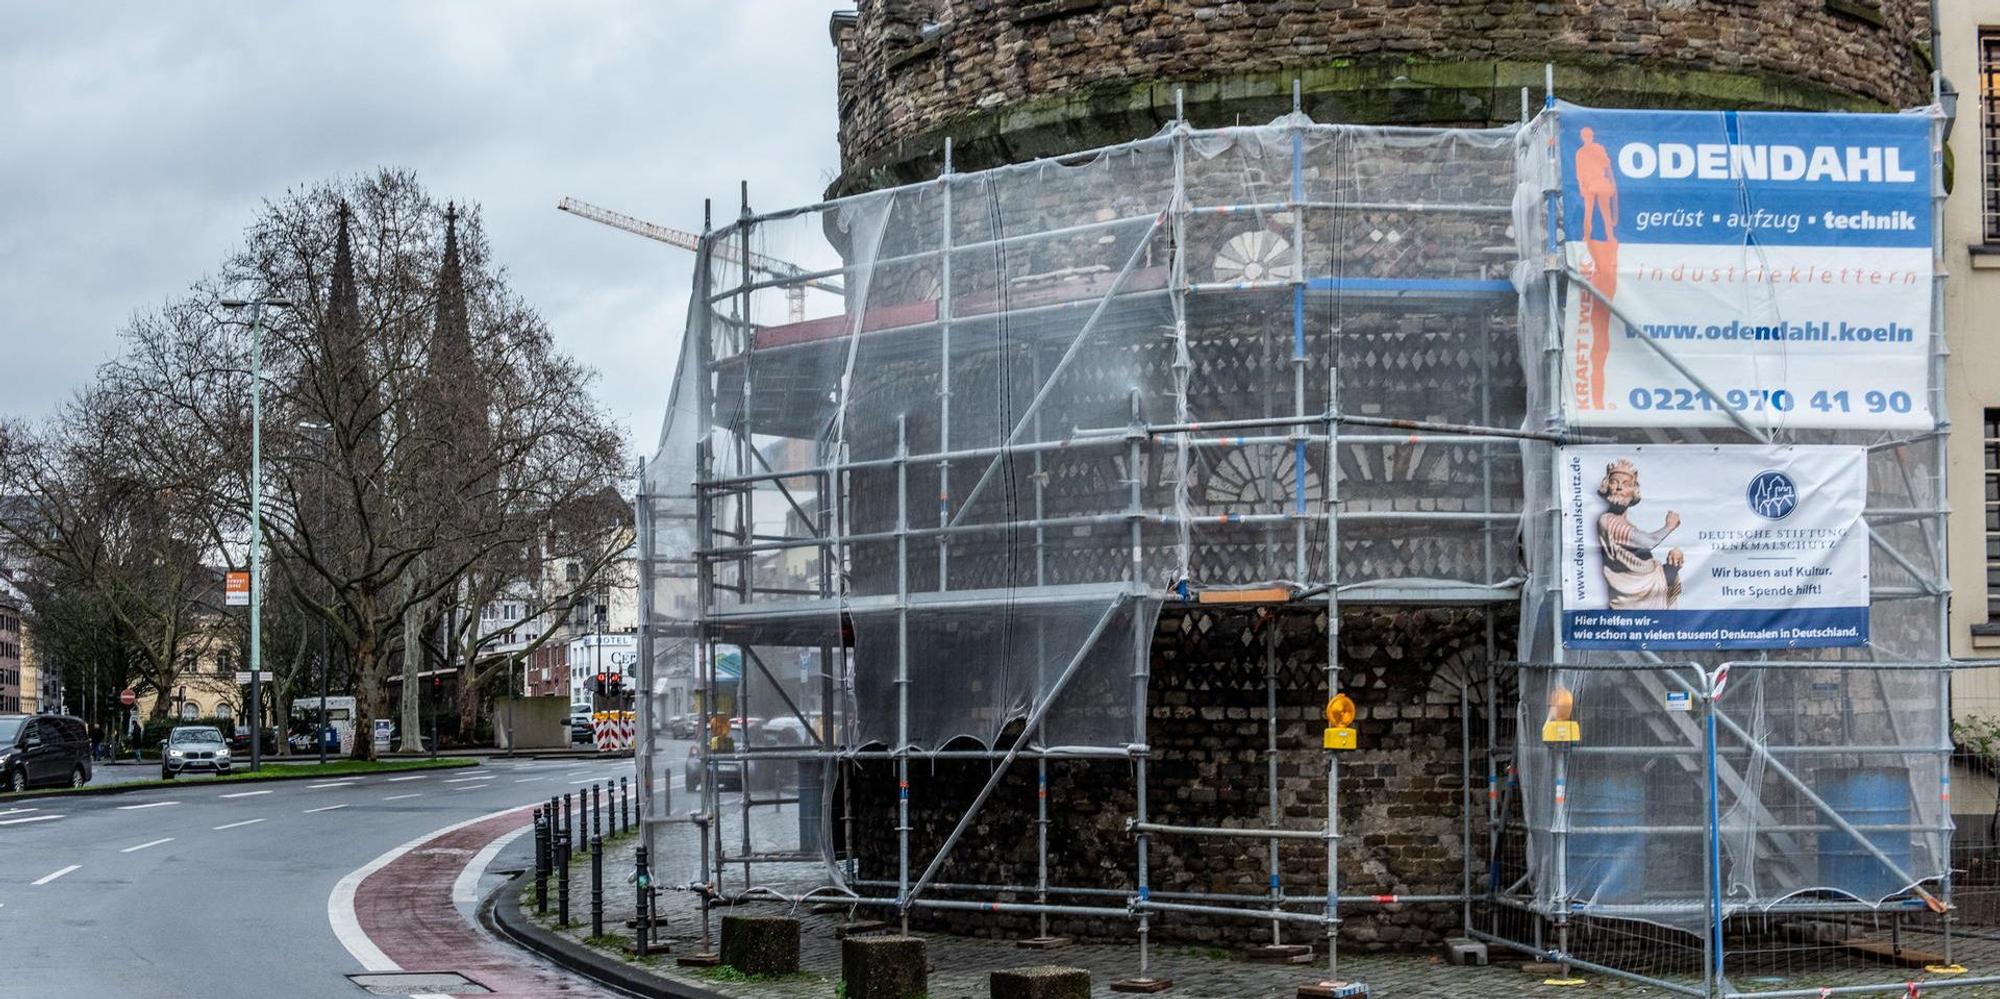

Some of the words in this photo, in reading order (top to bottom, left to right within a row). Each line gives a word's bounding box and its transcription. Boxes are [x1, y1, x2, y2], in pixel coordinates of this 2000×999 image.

[1618, 142, 1915, 183] ODENDAHL
[1636, 209, 1704, 231] gerüst
[1727, 208, 1800, 233] aufzug
[1823, 210, 1915, 231] technik
[1637, 264, 1917, 285] industrieklettern
[1625, 321, 1914, 342] www.odendahl.koeln
[1574, 339, 1590, 410] KRAFT
[1810, 391, 1851, 413] 41
[1865, 391, 1912, 413] 90
[1570, 456, 1585, 600] www.denkmalschutz.de
[1698, 530, 1772, 540] DEUTSCHE
[1777, 529, 1850, 539] STIFTUNG
[1711, 540, 1837, 550] DENKMALSCHUTZ
[1712, 568, 1731, 578] Wir
[1734, 567, 1771, 578] bauen
[1774, 567, 1793, 577] auf
[1796, 566, 1833, 577] Kultur.
[1722, 586, 1746, 596] Ihre
[1749, 585, 1793, 598] Spende
[1796, 584, 1822, 595] hilft!
[1574, 616, 1597, 626] Hier
[1600, 615, 1632, 626] helfen
[1634, 616, 1651, 626] wir
[1573, 629, 1592, 639] wie
[1595, 629, 1627, 640] schon
[1629, 632, 1642, 640] an
[1644, 629, 1675, 640] vielen
[1676, 630, 1718, 640] tausend
[1720, 629, 1779, 639] Denkmalen
[1780, 628, 1790, 638] in
[1792, 626, 1859, 638] Deutschland.
